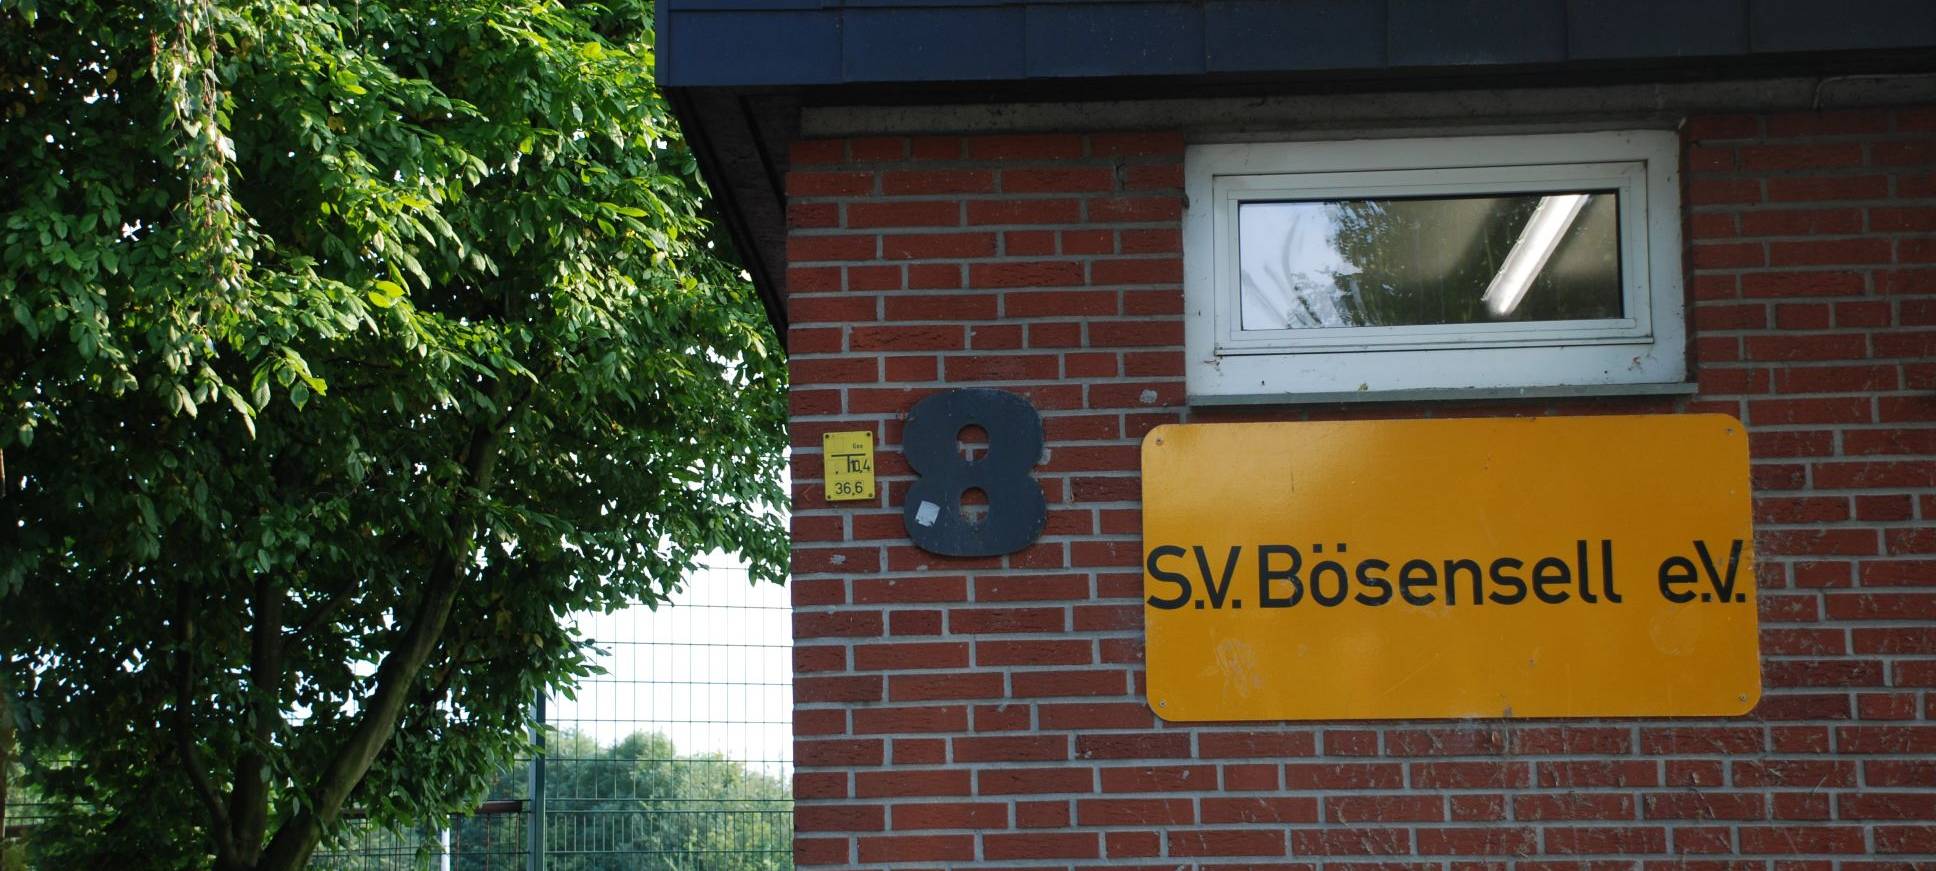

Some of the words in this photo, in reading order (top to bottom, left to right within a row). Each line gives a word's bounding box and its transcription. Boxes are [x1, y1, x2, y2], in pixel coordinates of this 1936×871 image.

[835, 481, 863, 496] 36,6
[903, 387, 1046, 557] 8
[1147, 545, 1242, 609] S.V.
[1258, 540, 1622, 609] Bösensell
[1658, 540, 1746, 603] e.V.
